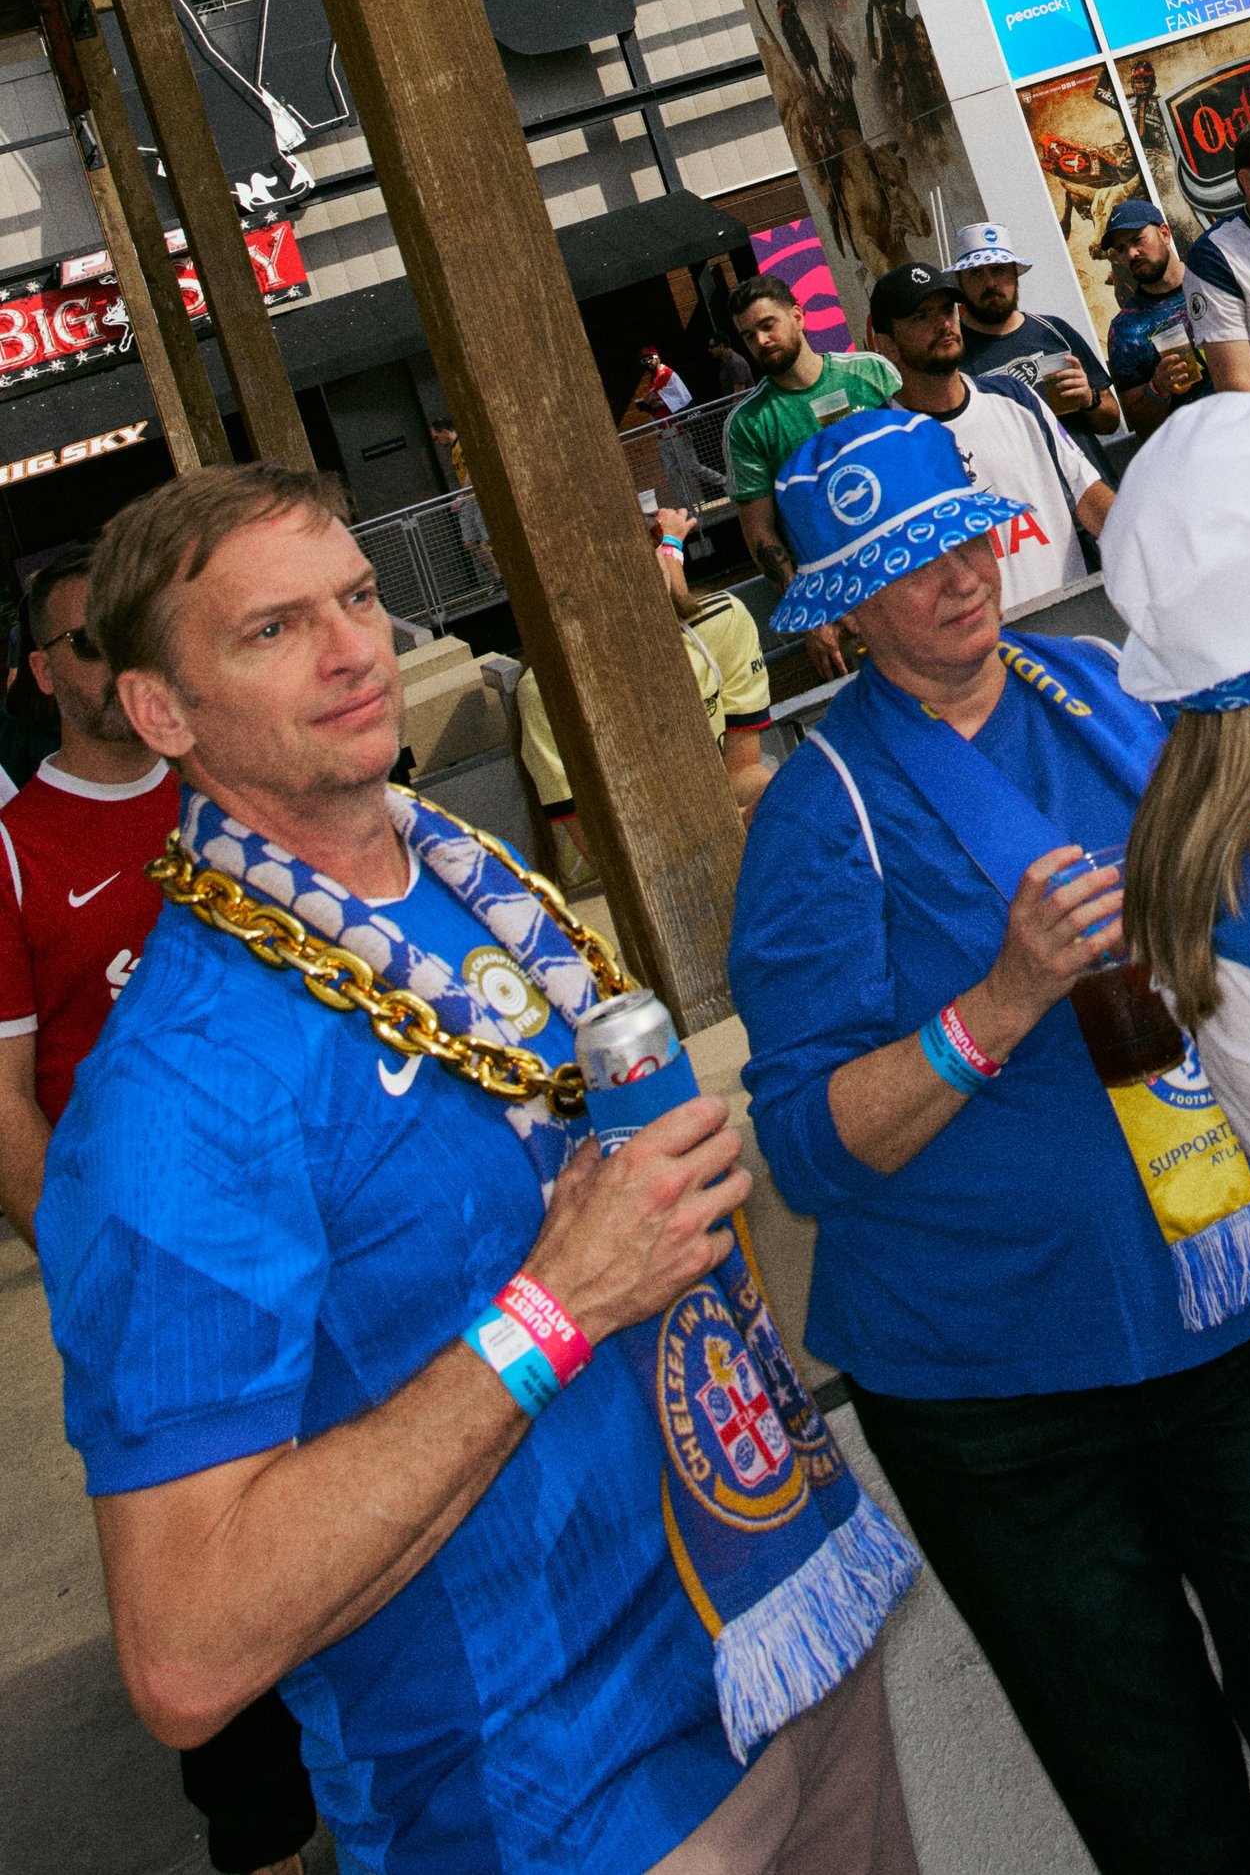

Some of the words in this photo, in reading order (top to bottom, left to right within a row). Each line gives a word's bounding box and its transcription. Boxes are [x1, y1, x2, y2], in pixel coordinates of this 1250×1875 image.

[1165, 6, 1202, 33] FAN
[0, 297, 107, 371] BIG
[61, 420, 148, 466] SKY
[989, 511, 1050, 559] IA
[946, 1006, 987, 1066] SATURDAY
[1149, 1123, 1229, 1178] SUPPORT
[505, 1292, 553, 1339] GUEST
[510, 1274, 576, 1342] SATURDAY
[667, 1334, 712, 1482] CHELSEA
